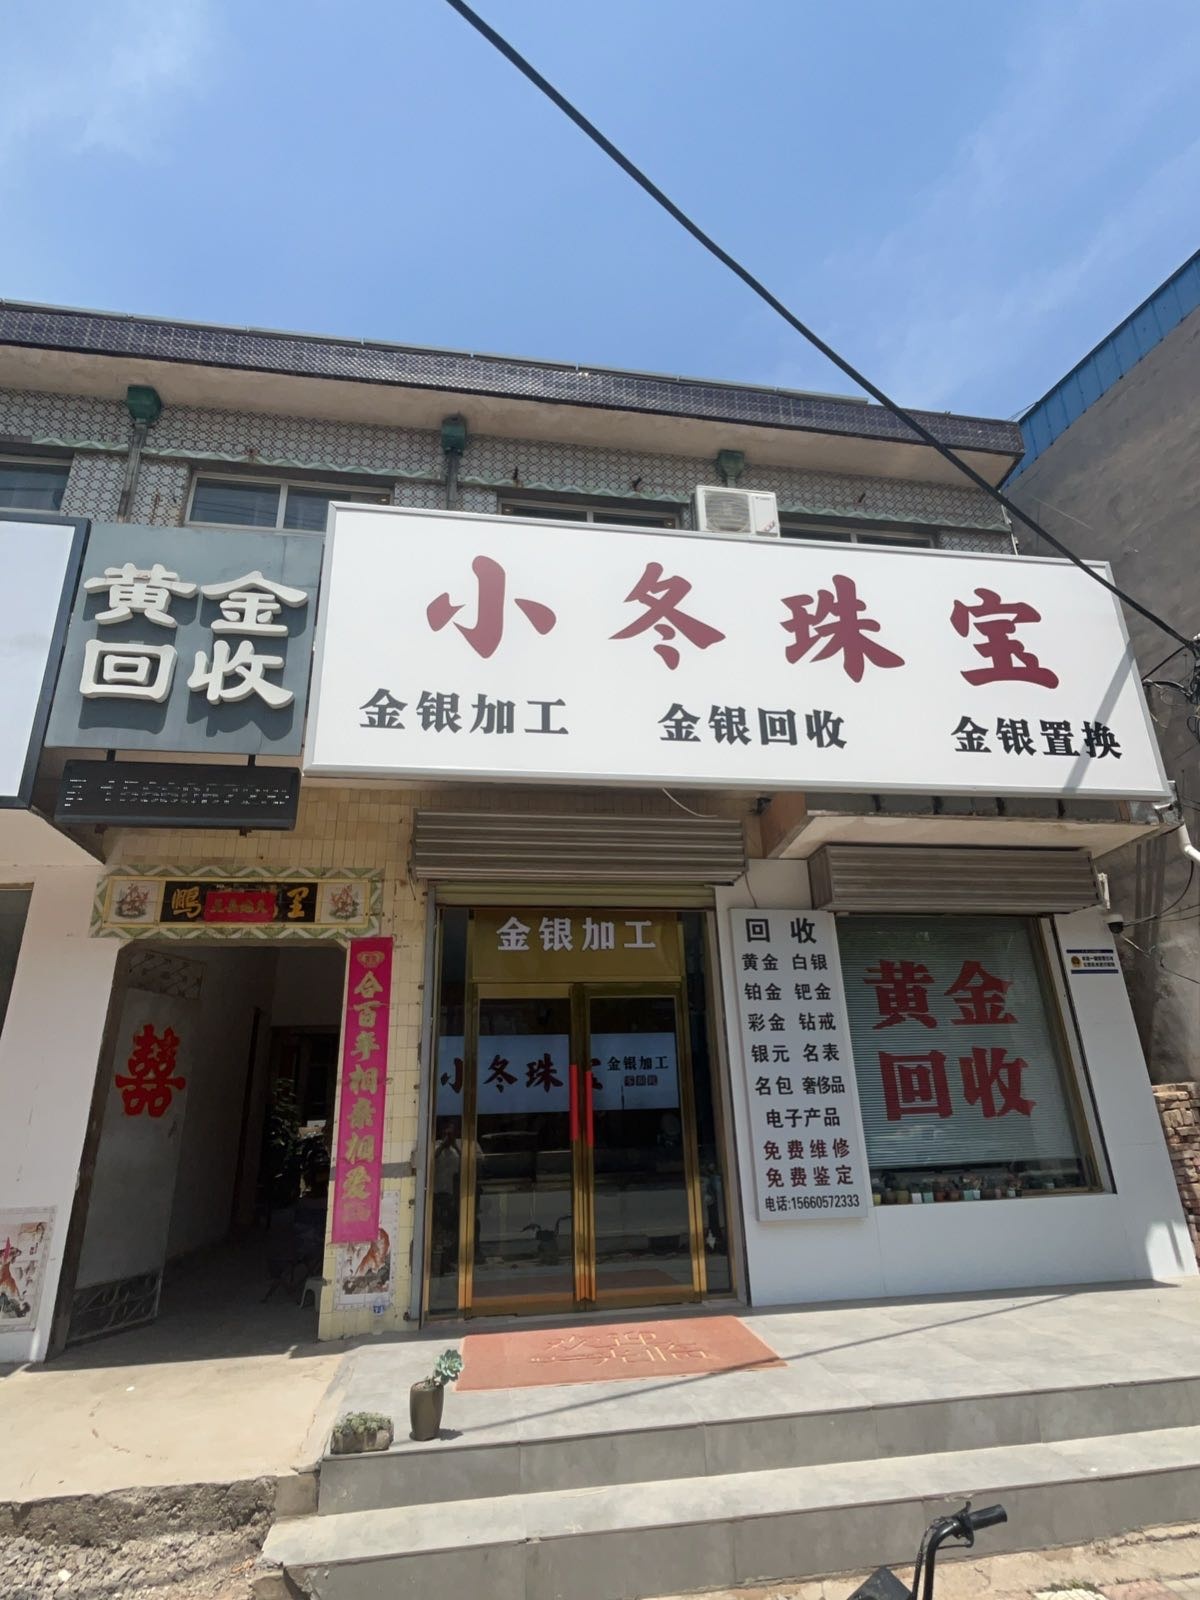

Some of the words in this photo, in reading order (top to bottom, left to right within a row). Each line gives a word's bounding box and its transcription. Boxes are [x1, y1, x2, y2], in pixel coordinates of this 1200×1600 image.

[83, 562, 308, 637] 黄金
[426, 555, 1060, 690] 小冬珠宝
[79, 639, 295, 708] 回收
[360, 688, 568, 735] 金银加工
[658, 703, 847, 748] 金银回收
[951, 716, 1122, 760] 金银置换
[496, 917, 656, 951] 金银加工
[742, 953, 778, 970] 黄金
[793, 954, 827, 970] 白银
[744, 983, 781, 1000] 铂金
[795, 983, 831, 1000] 钯金
[863, 959, 1018, 1030] 黄金
[748, 1013, 785, 1032] 彩金
[799, 1012, 836, 1032] 钻戒
[607, 1056, 669, 1071] 金银加工
[752, 1044, 789, 1062] 银元
[803, 1043, 839, 1062] 名表
[755, 1076, 793, 1095] 名包
[802, 1075, 845, 1095] 奢侈品
[877, 1047, 1036, 1121] 回收
[767, 1107, 840, 1128] 电子产品
[763, 1138, 850, 1160] 免费维修
[766, 1165, 853, 1187] 免费鉴定
